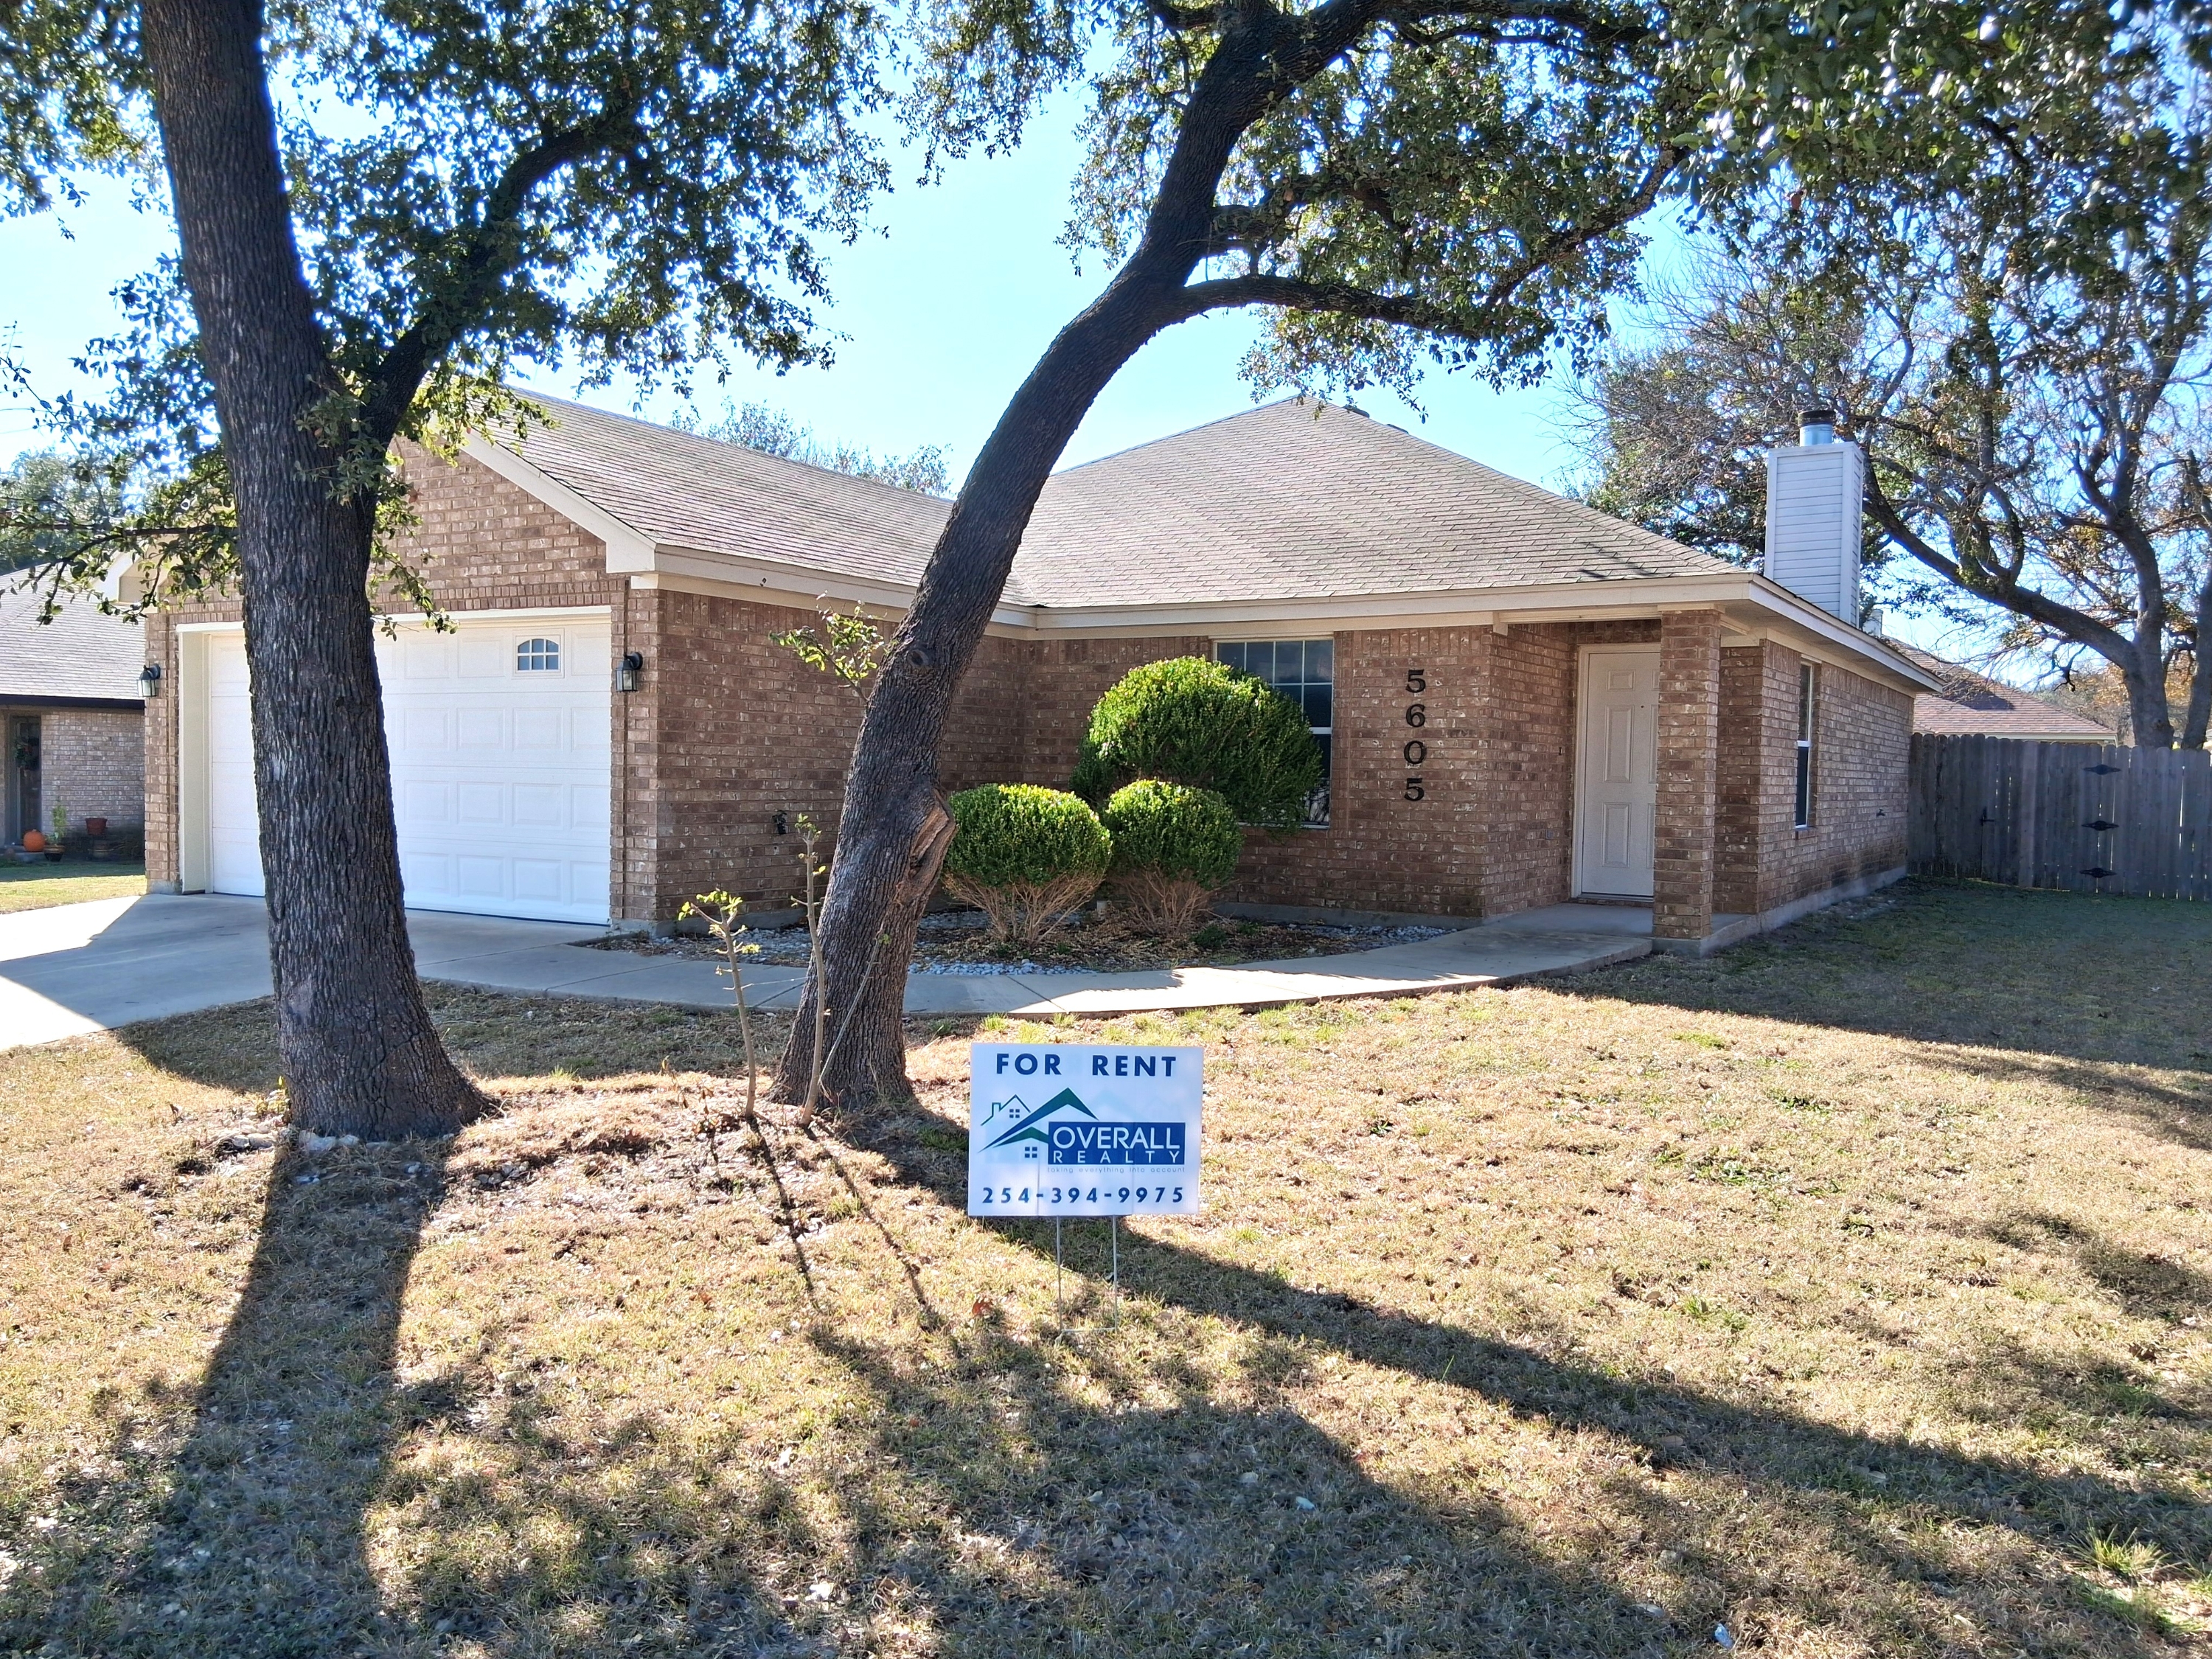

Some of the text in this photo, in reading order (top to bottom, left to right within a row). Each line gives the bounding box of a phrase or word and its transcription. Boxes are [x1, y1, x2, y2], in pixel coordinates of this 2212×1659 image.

[1404, 669, 1427, 801] 5605
[996, 1053, 1177, 1077] FOR RENT
[1052, 1126, 1180, 1150] OVERALL
[1052, 1150, 1180, 1164] REALTY
[982, 1187, 1183, 1203] 254-394-9975
